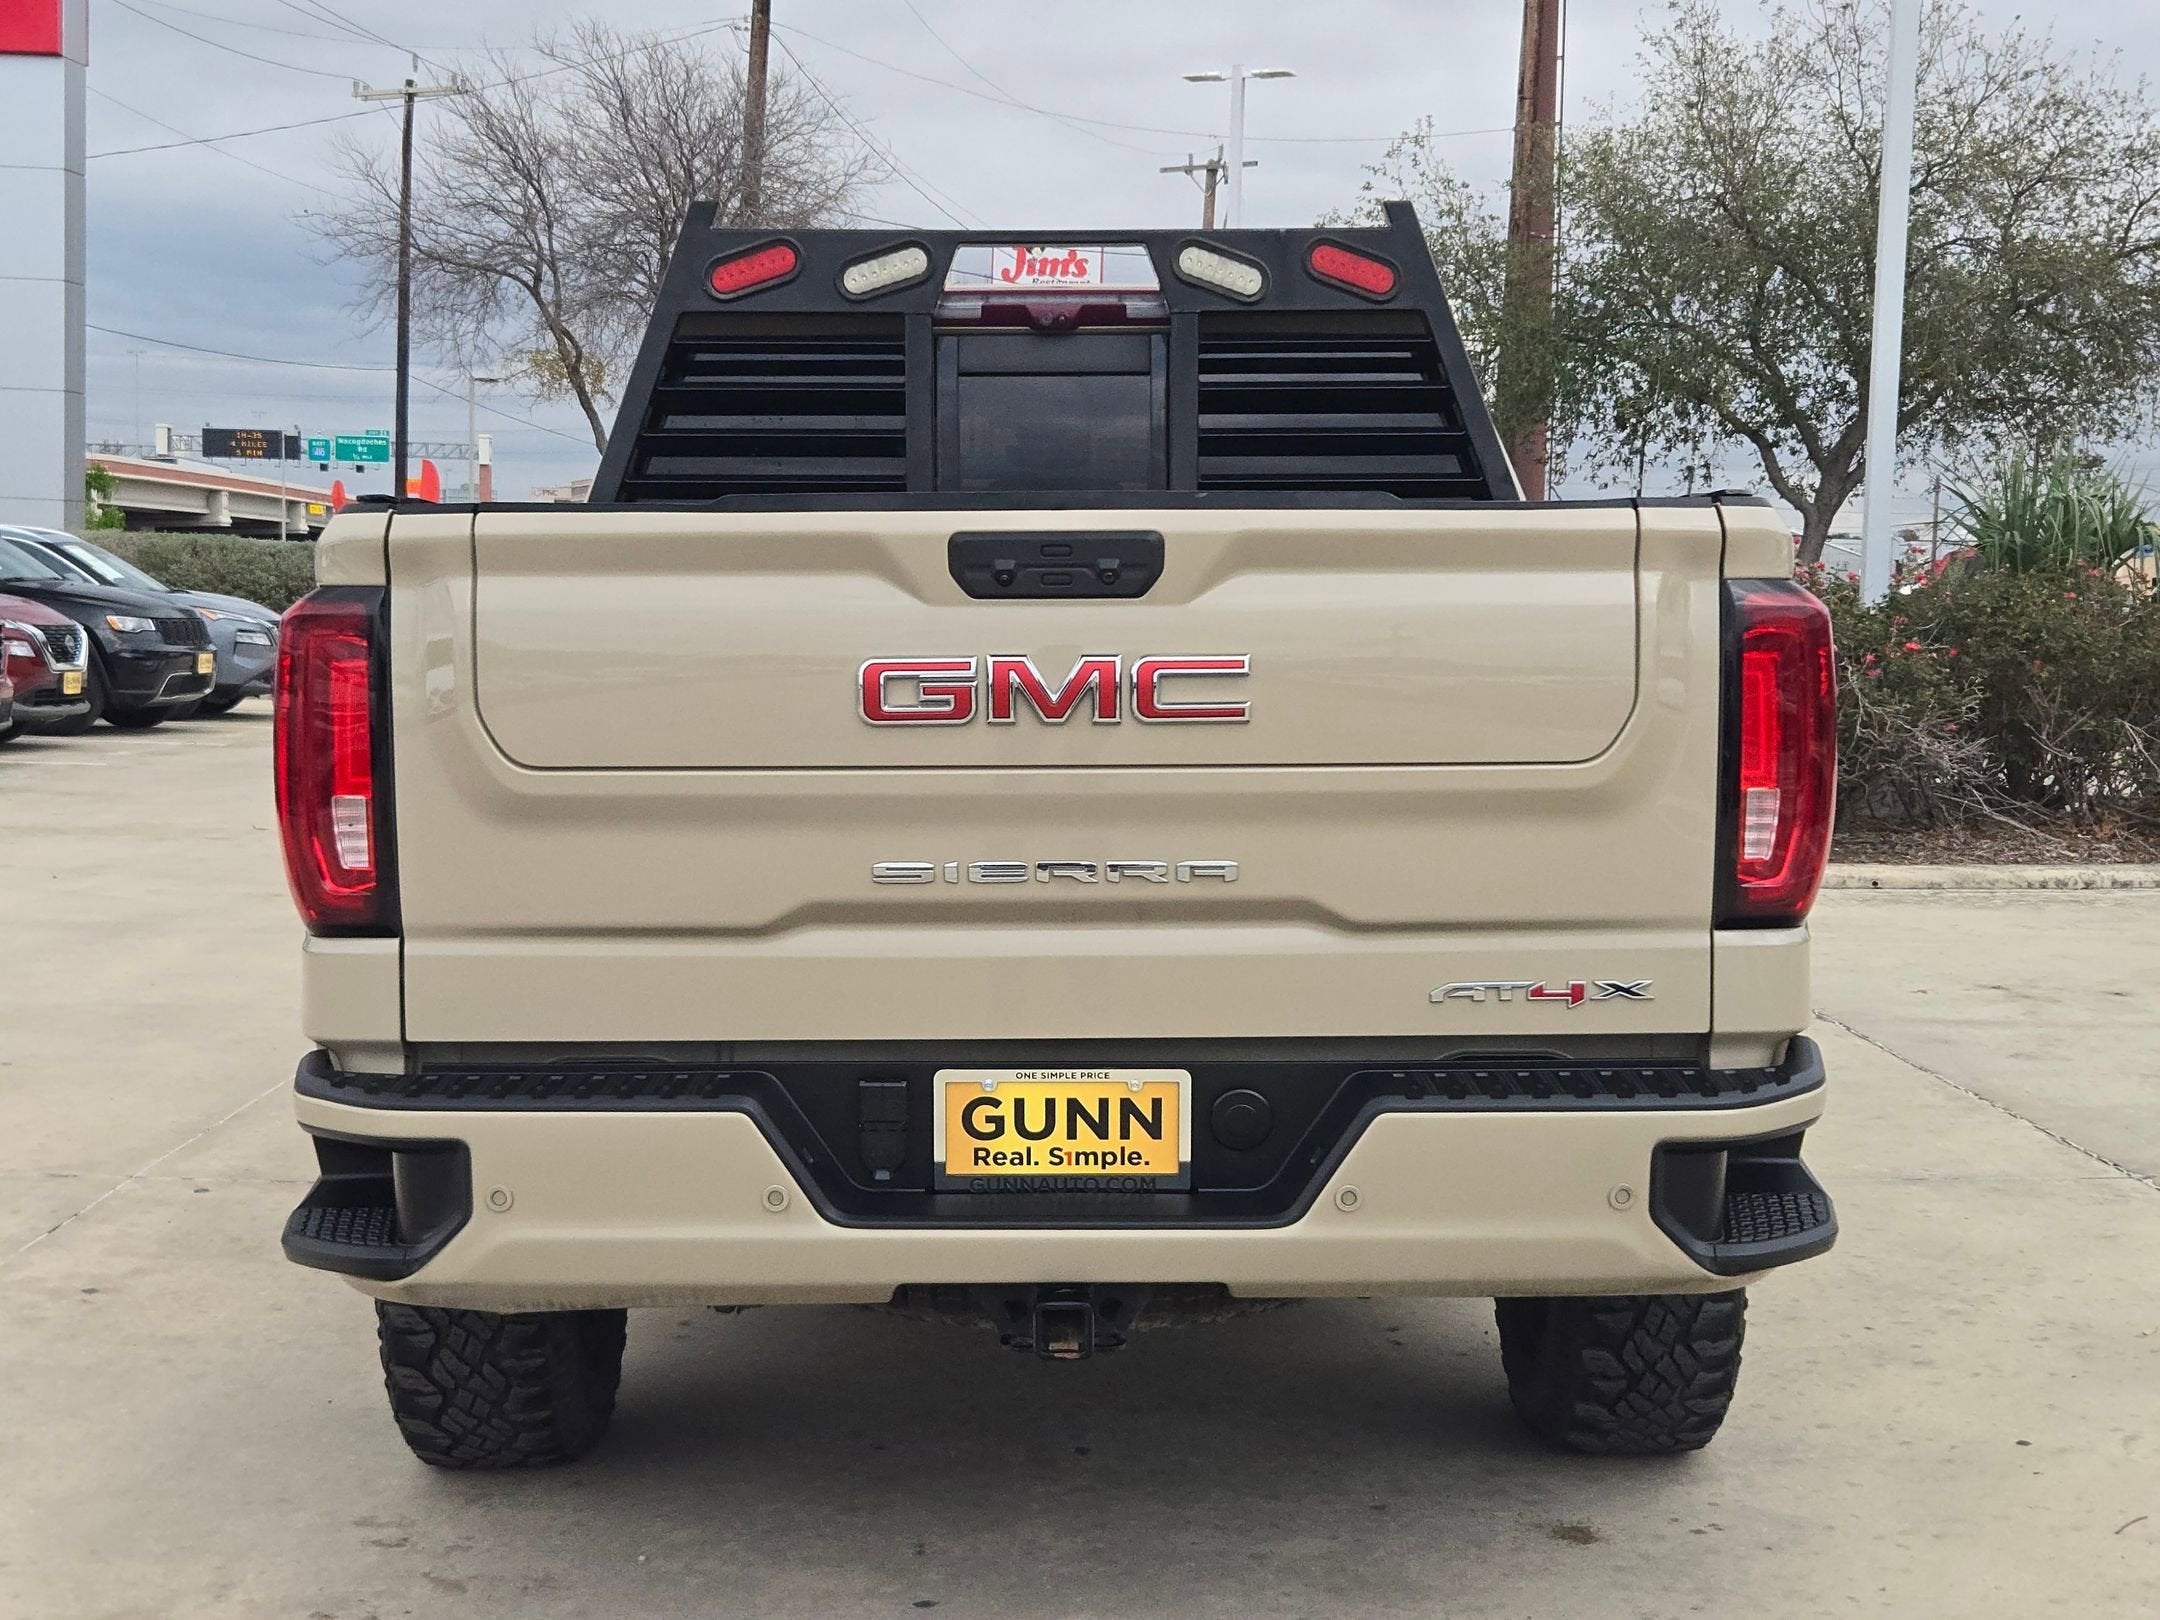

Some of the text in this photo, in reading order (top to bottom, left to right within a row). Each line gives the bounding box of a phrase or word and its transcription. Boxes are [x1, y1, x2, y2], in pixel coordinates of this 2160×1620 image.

[1001, 245, 1089, 283] Jim's
[337, 438, 387, 446] Nacogdoches
[858, 654, 1251, 726] GMC
[872, 860, 1240, 884] SIERRA
[1429, 979, 1656, 1009] AT4X
[1015, 1071, 1110, 1080] ONE SIMPLE PRICE
[961, 1096, 1162, 1141] GUNN
[973, 1146, 1039, 1167] Real.
[969, 1177, 1157, 1193] GUNNAUTO.COM
